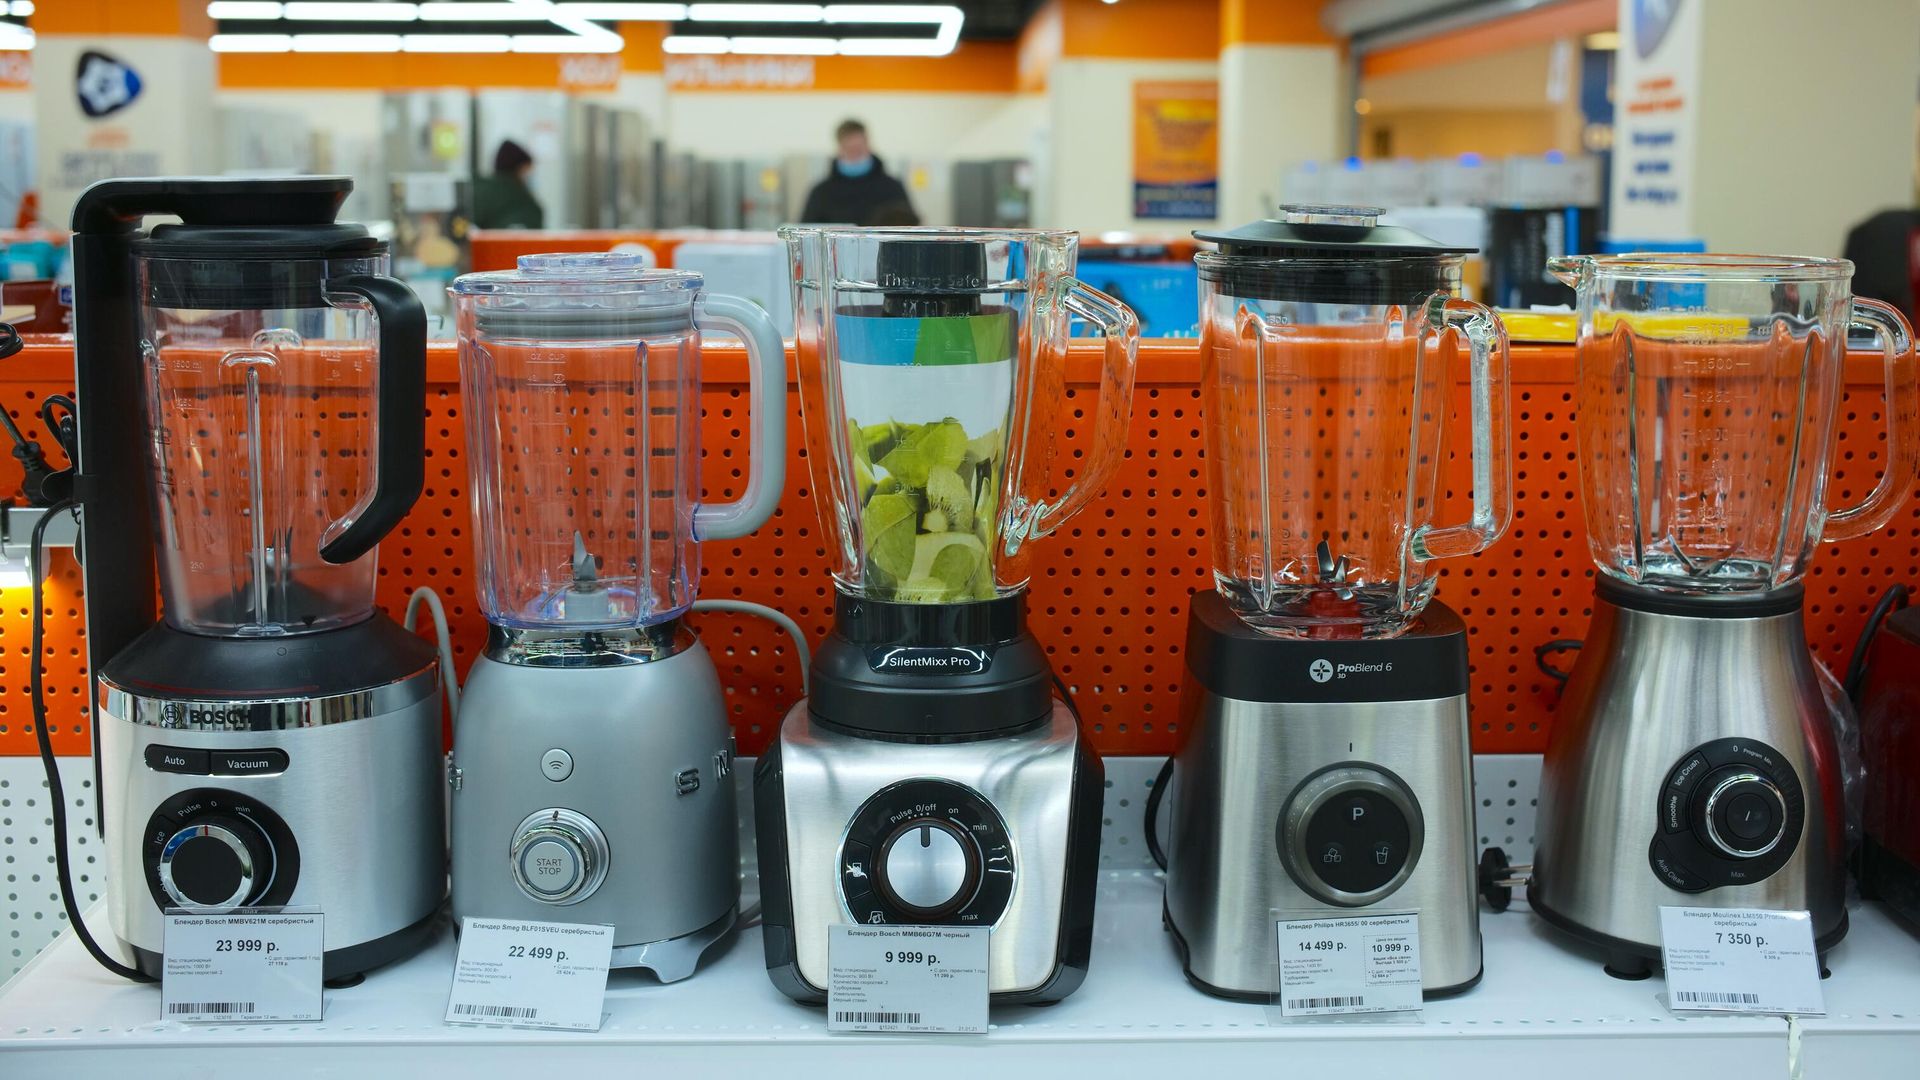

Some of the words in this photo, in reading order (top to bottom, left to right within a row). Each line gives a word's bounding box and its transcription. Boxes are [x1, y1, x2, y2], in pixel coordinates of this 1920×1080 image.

[947, 273, 980, 288] Safe
[1702, 358, 1733, 370] 1500
[889, 657, 948, 667] SilentMixx
[950, 657, 971, 667] Pro
[1336, 662, 1384, 672] ProBlend
[1385, 662, 1393, 671] 6
[189, 709, 252, 725] BOSCH
[164, 755, 186, 766] Auto
[227, 759, 269, 769] Vacuum
[1674, 776, 1686, 786] Ice
[1681, 758, 1701, 777] Crush
[177, 803, 202, 817] Pulse
[235, 805, 251, 813] min
[890, 807, 913, 824] Pulse
[915, 803, 937, 812] 0/off
[1353, 807, 1365, 820] P
[1671, 795, 1679, 829] Smoothie
[972, 823, 988, 831] min
[154, 831, 166, 845] Ice
[536, 858, 562, 867] START
[538, 866, 562, 876] STOP
[1656, 858, 1669, 874] Auto
[1667, 869, 1686, 886] Clean
[961, 913, 979, 921] max
[1683, 911, 1712, 919] Блендер
[1712, 911, 1741, 919] Moulinex
[174, 918, 204, 926] Блендер
[267, 918, 314, 927] серебристый
[1369, 918, 1410, 927] серебристый
[1714, 920, 1758, 928] серебристый
[472, 922, 501, 932] Блендер
[501, 924, 520, 932] Smeg
[560, 928, 605, 937] серебристый
[847, 929, 878, 938] Блендер
[1715, 932, 1723, 944] 7
[1727, 933, 1751, 945] 350
[216, 939, 233, 952] 23
[237, 939, 262, 952] 999
[1298, 942, 1312, 952] 14
[1315, 940, 1334, 951] 499
[1372, 944, 1383, 953] 10
[1384, 943, 1402, 952] 999
[508, 945, 525, 958] 22
[528, 946, 553, 960] 499
[885, 951, 893, 963] 9
[897, 951, 923, 964] 999
